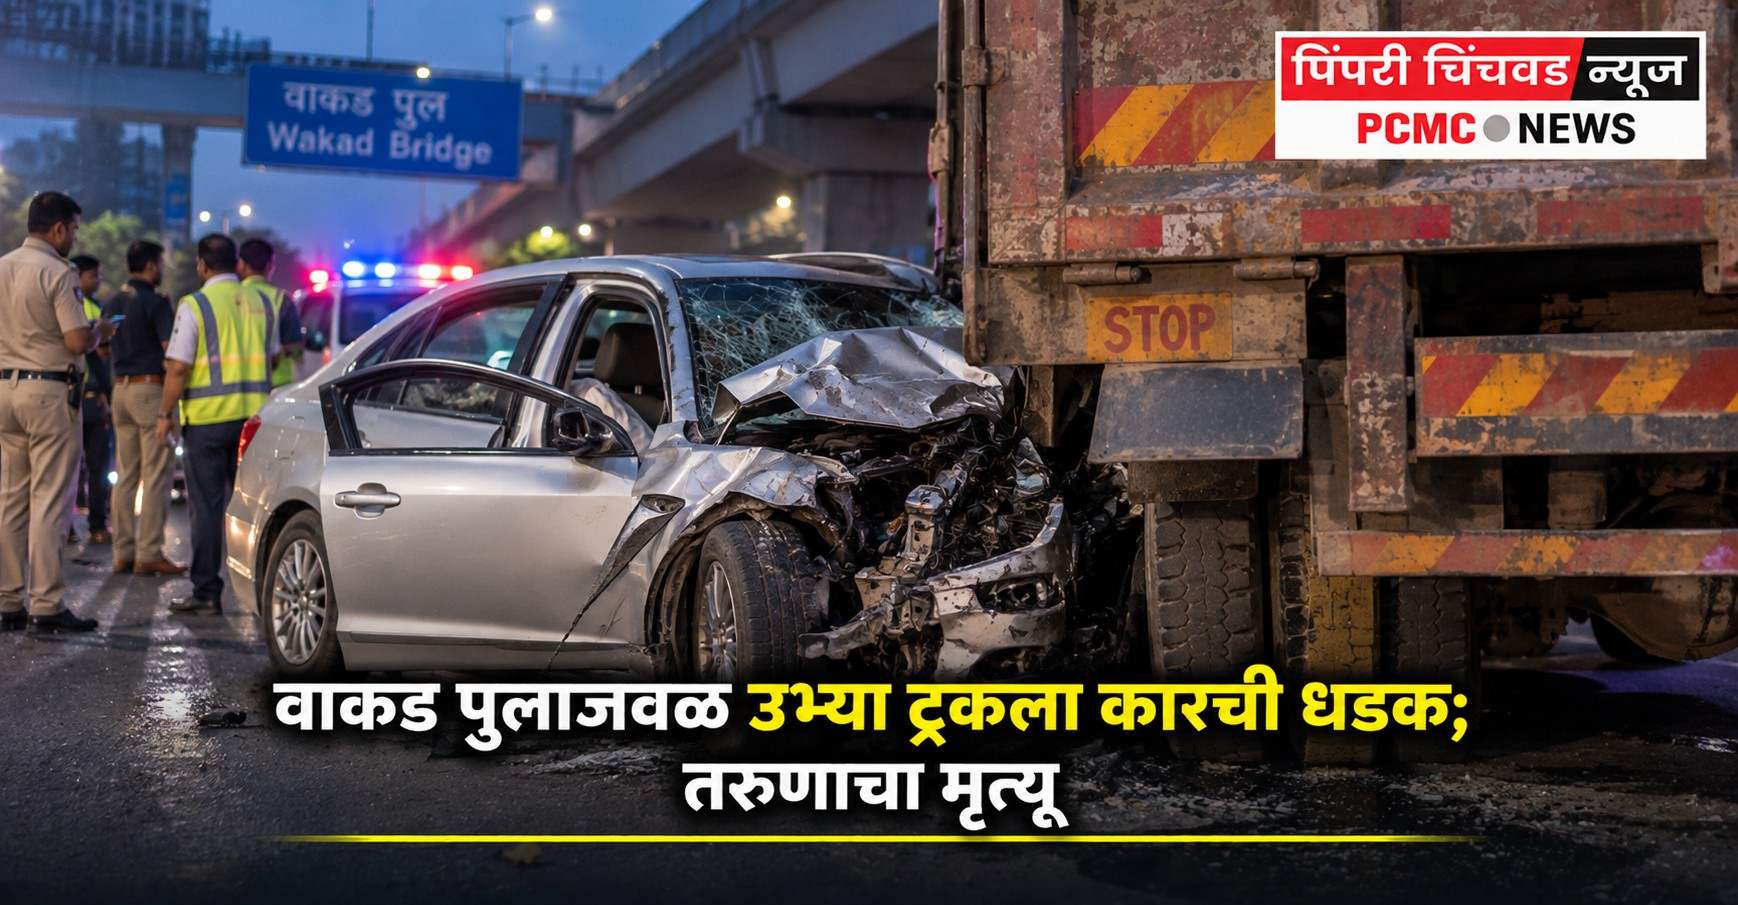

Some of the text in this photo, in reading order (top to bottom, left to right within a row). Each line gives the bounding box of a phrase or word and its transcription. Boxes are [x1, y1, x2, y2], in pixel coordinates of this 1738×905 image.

[283, 81, 449, 130] वाकड पुल
[267, 120, 493, 171] Wakad Bridge
[1103, 303, 1216, 353] STOP
